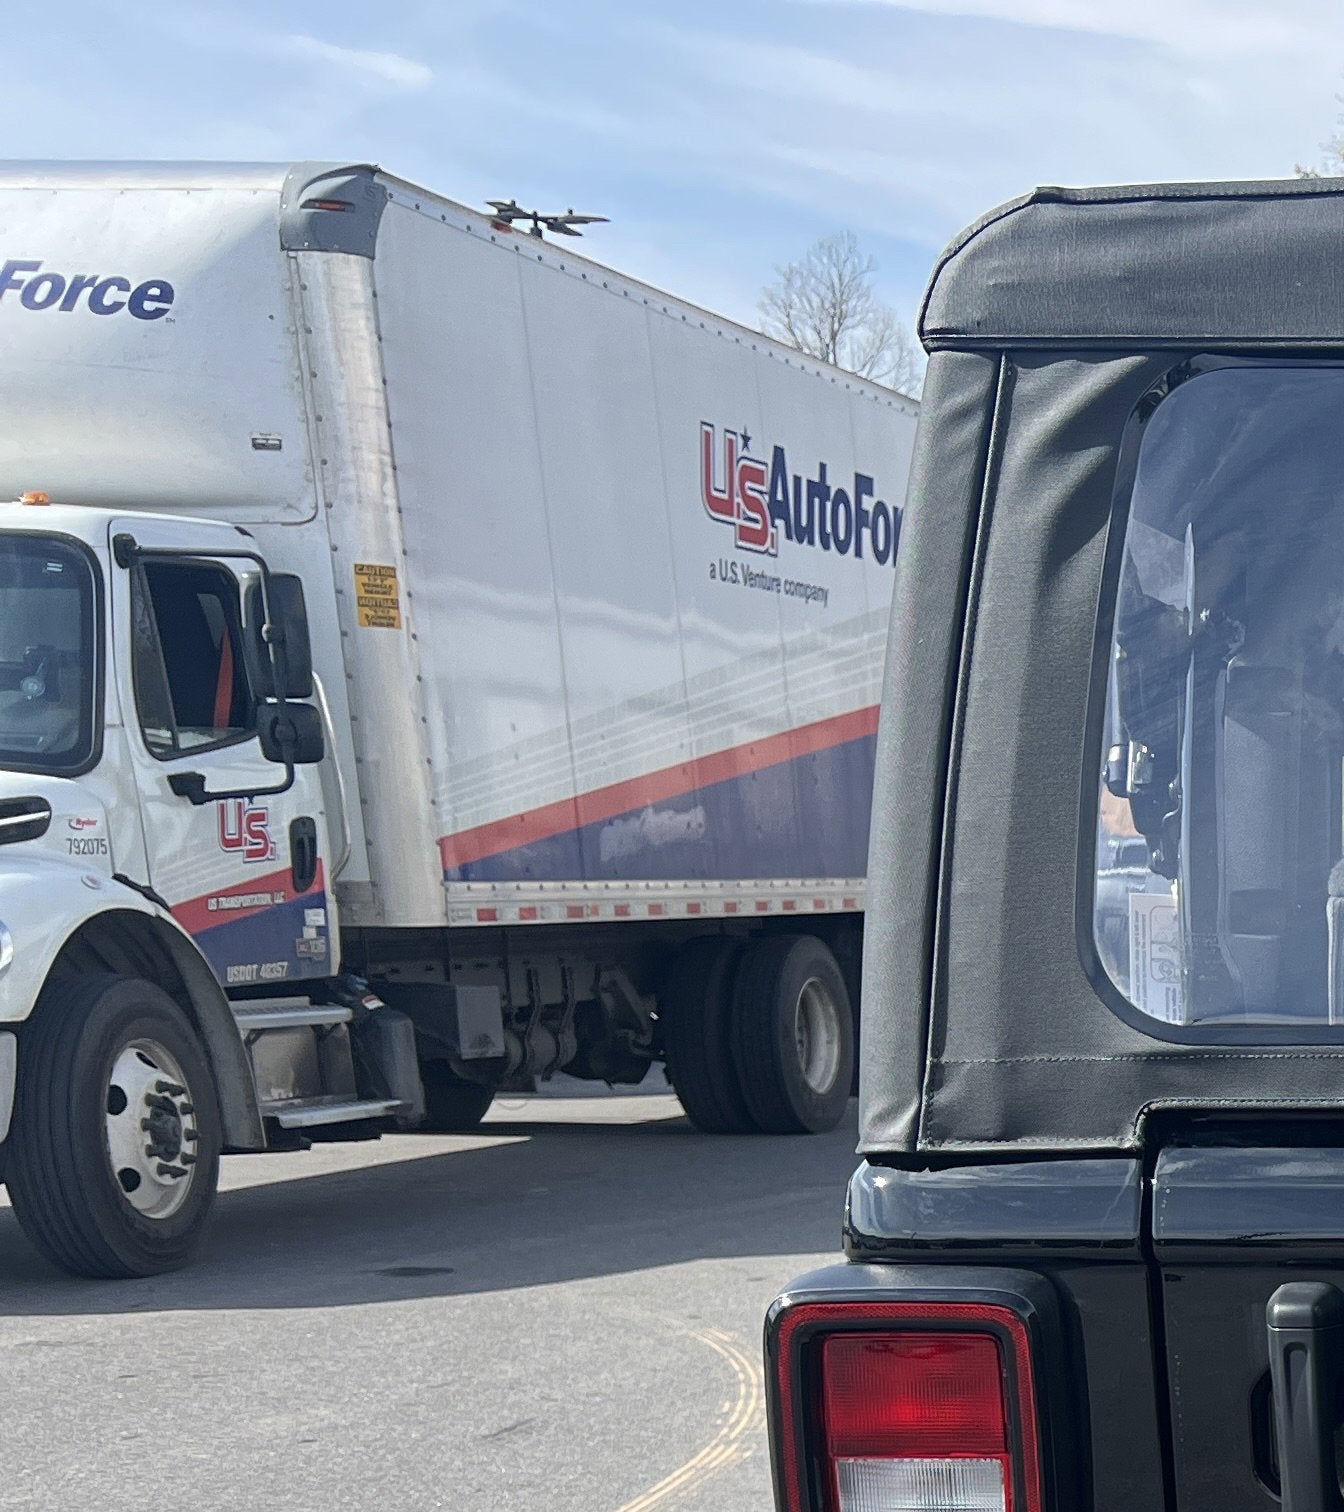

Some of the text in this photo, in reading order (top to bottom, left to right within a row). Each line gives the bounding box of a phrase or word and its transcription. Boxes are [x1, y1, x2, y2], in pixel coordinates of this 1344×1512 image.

[709, 562, 717, 580] a
[741, 562, 781, 594] Venture
[784, 578, 829, 608] company
[66, 838, 108, 856] 792075
[227, 964, 258, 983] USDOT
